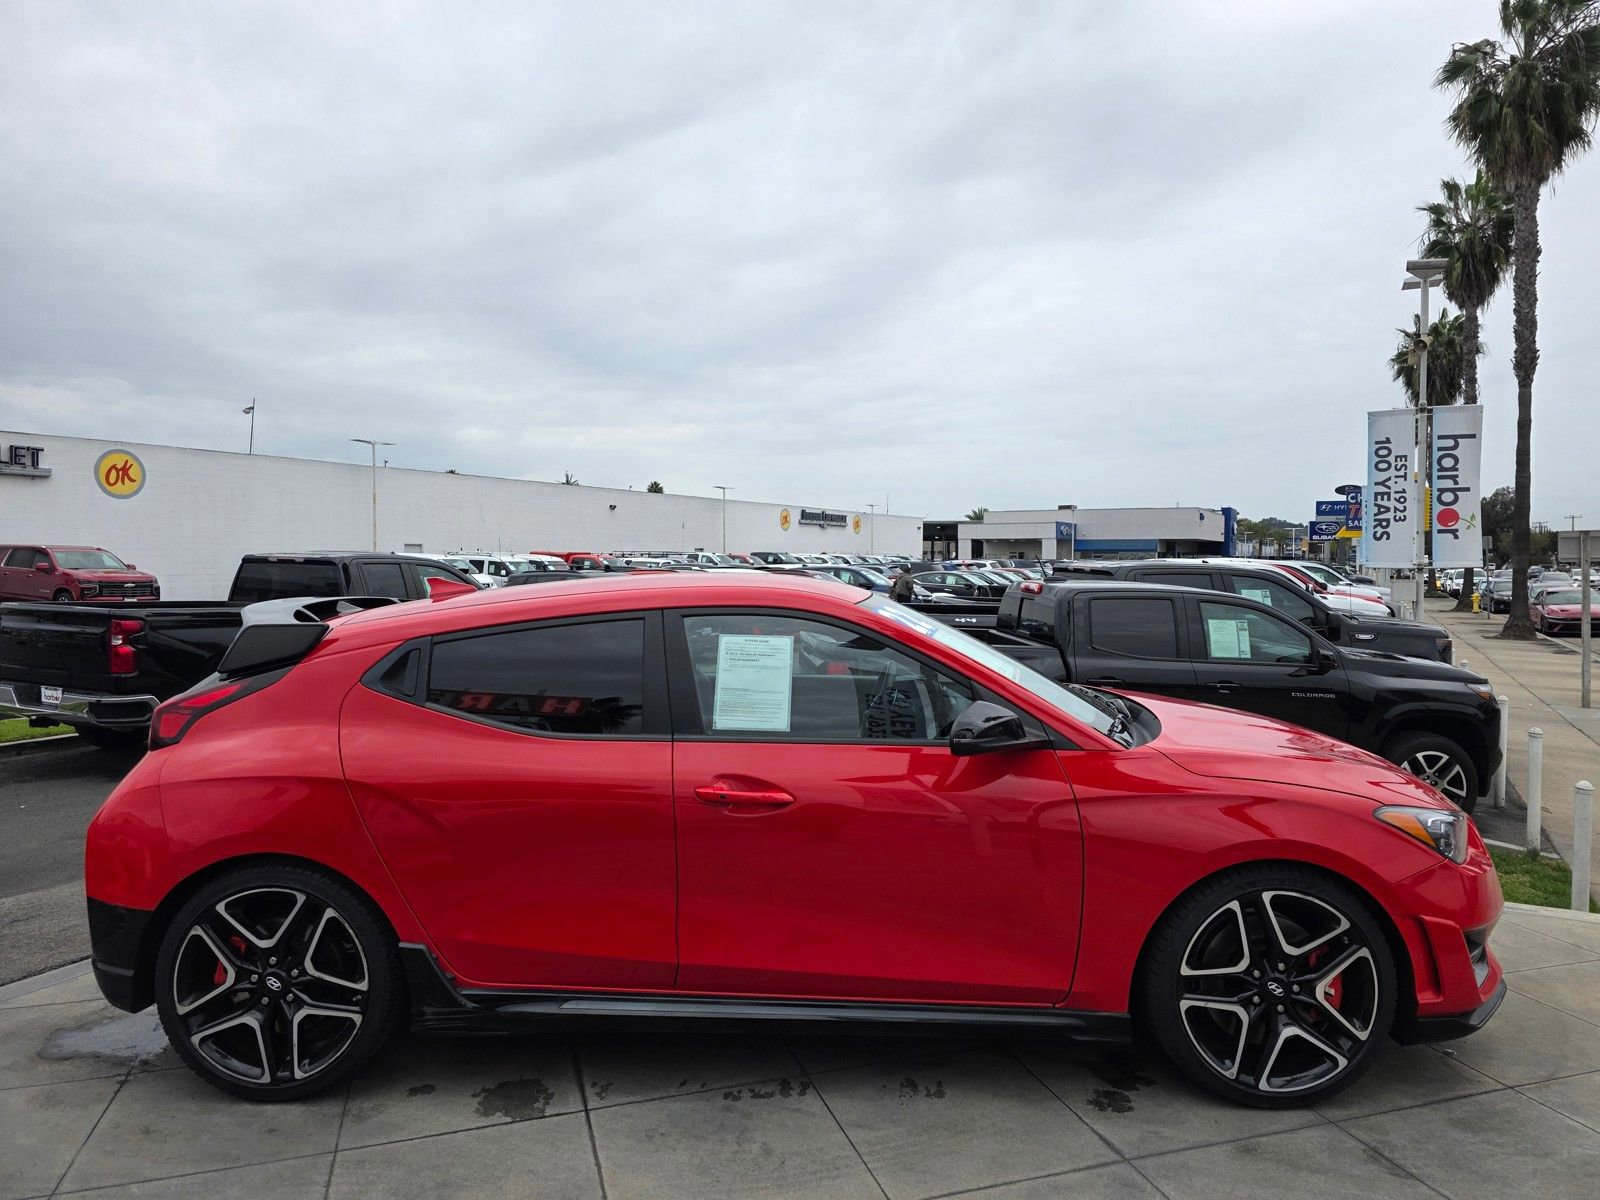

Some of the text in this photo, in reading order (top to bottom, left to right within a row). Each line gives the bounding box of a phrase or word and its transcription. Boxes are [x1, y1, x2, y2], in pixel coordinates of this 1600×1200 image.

[104, 459, 137, 487] OK
[1372, 436, 1393, 542] 100 YEARS
[1393, 454, 1408, 523] EST. 1923
[1436, 433, 1477, 540] harbor
